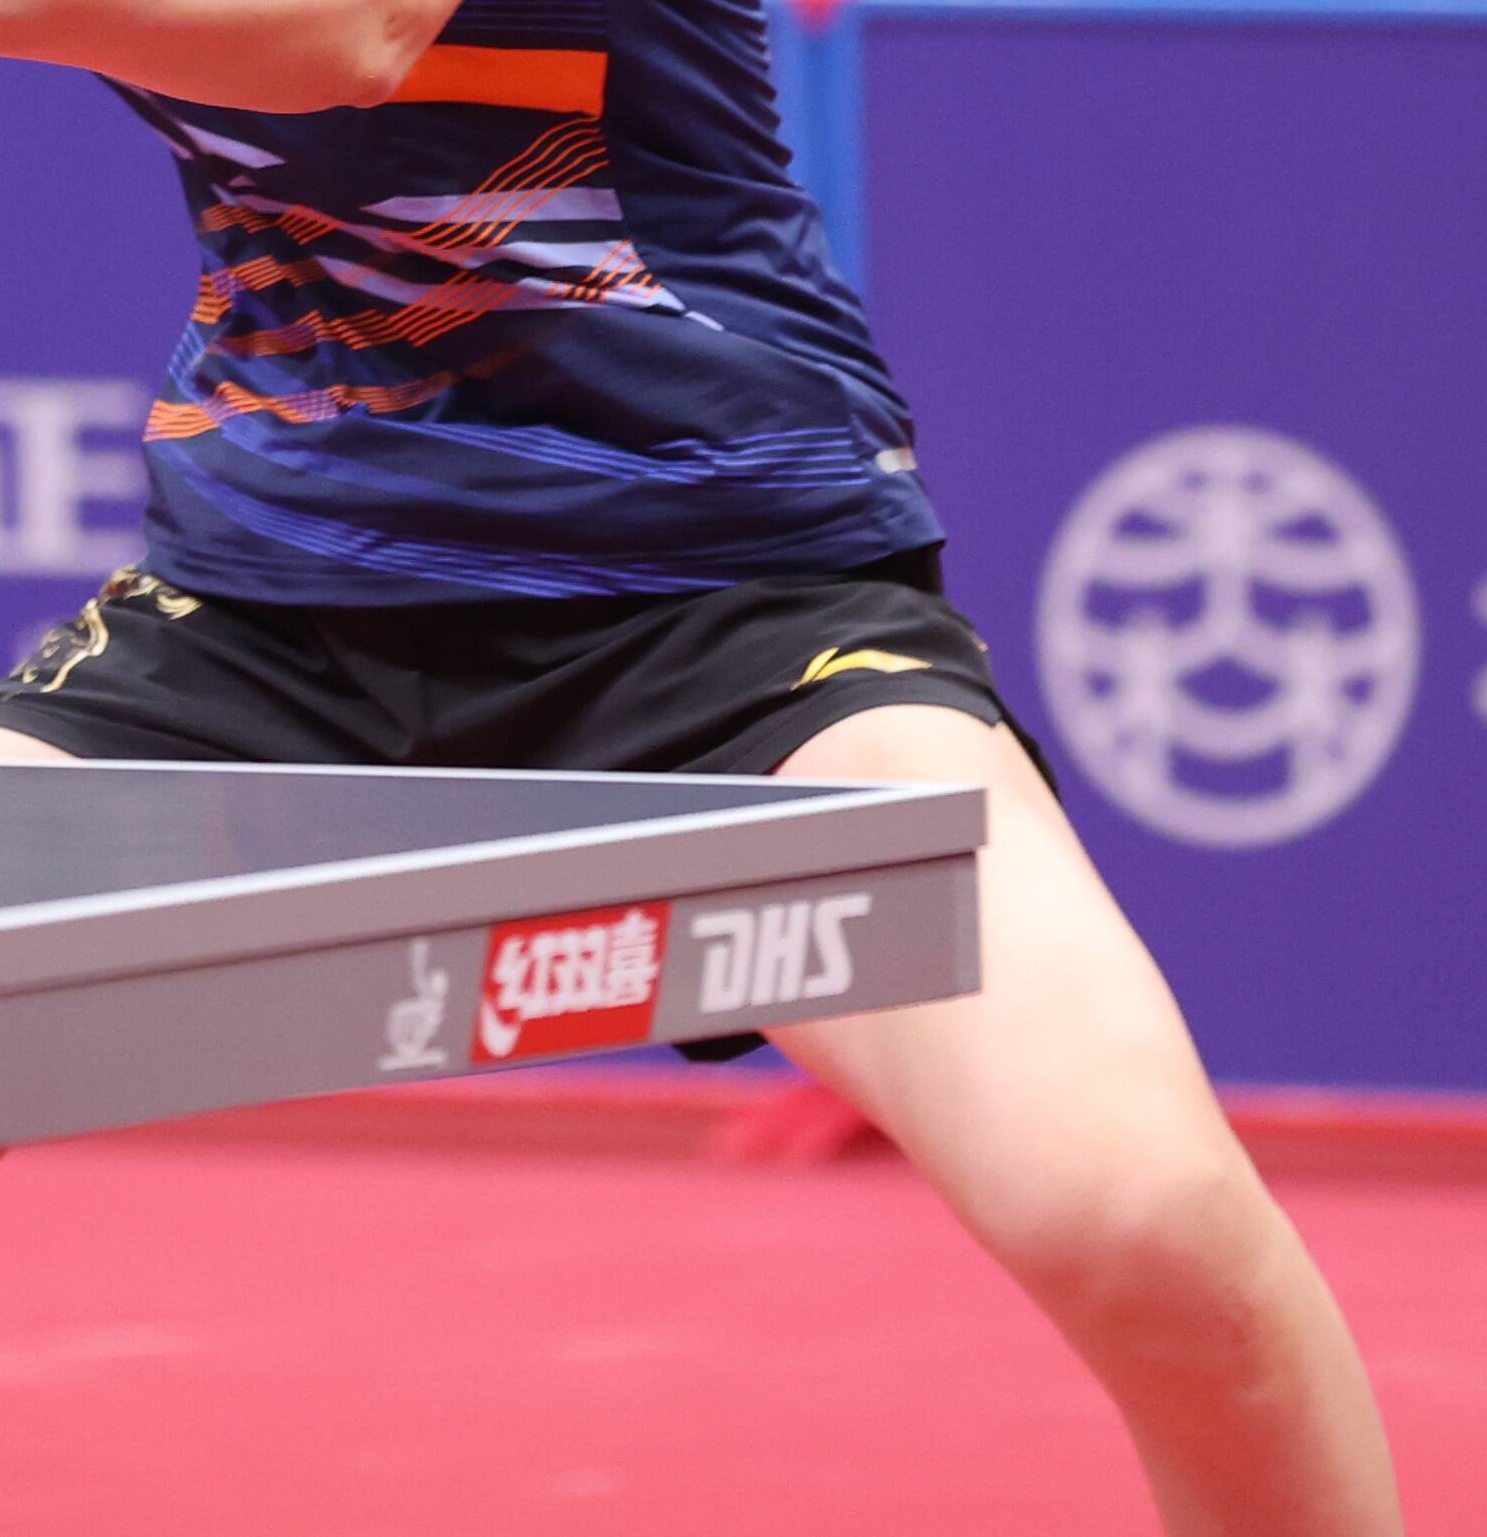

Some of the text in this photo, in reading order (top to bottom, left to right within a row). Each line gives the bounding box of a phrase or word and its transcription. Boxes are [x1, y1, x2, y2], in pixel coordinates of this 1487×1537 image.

[480, 908, 660, 1057] 红双喜
[689, 893, 872, 1014] DHS
